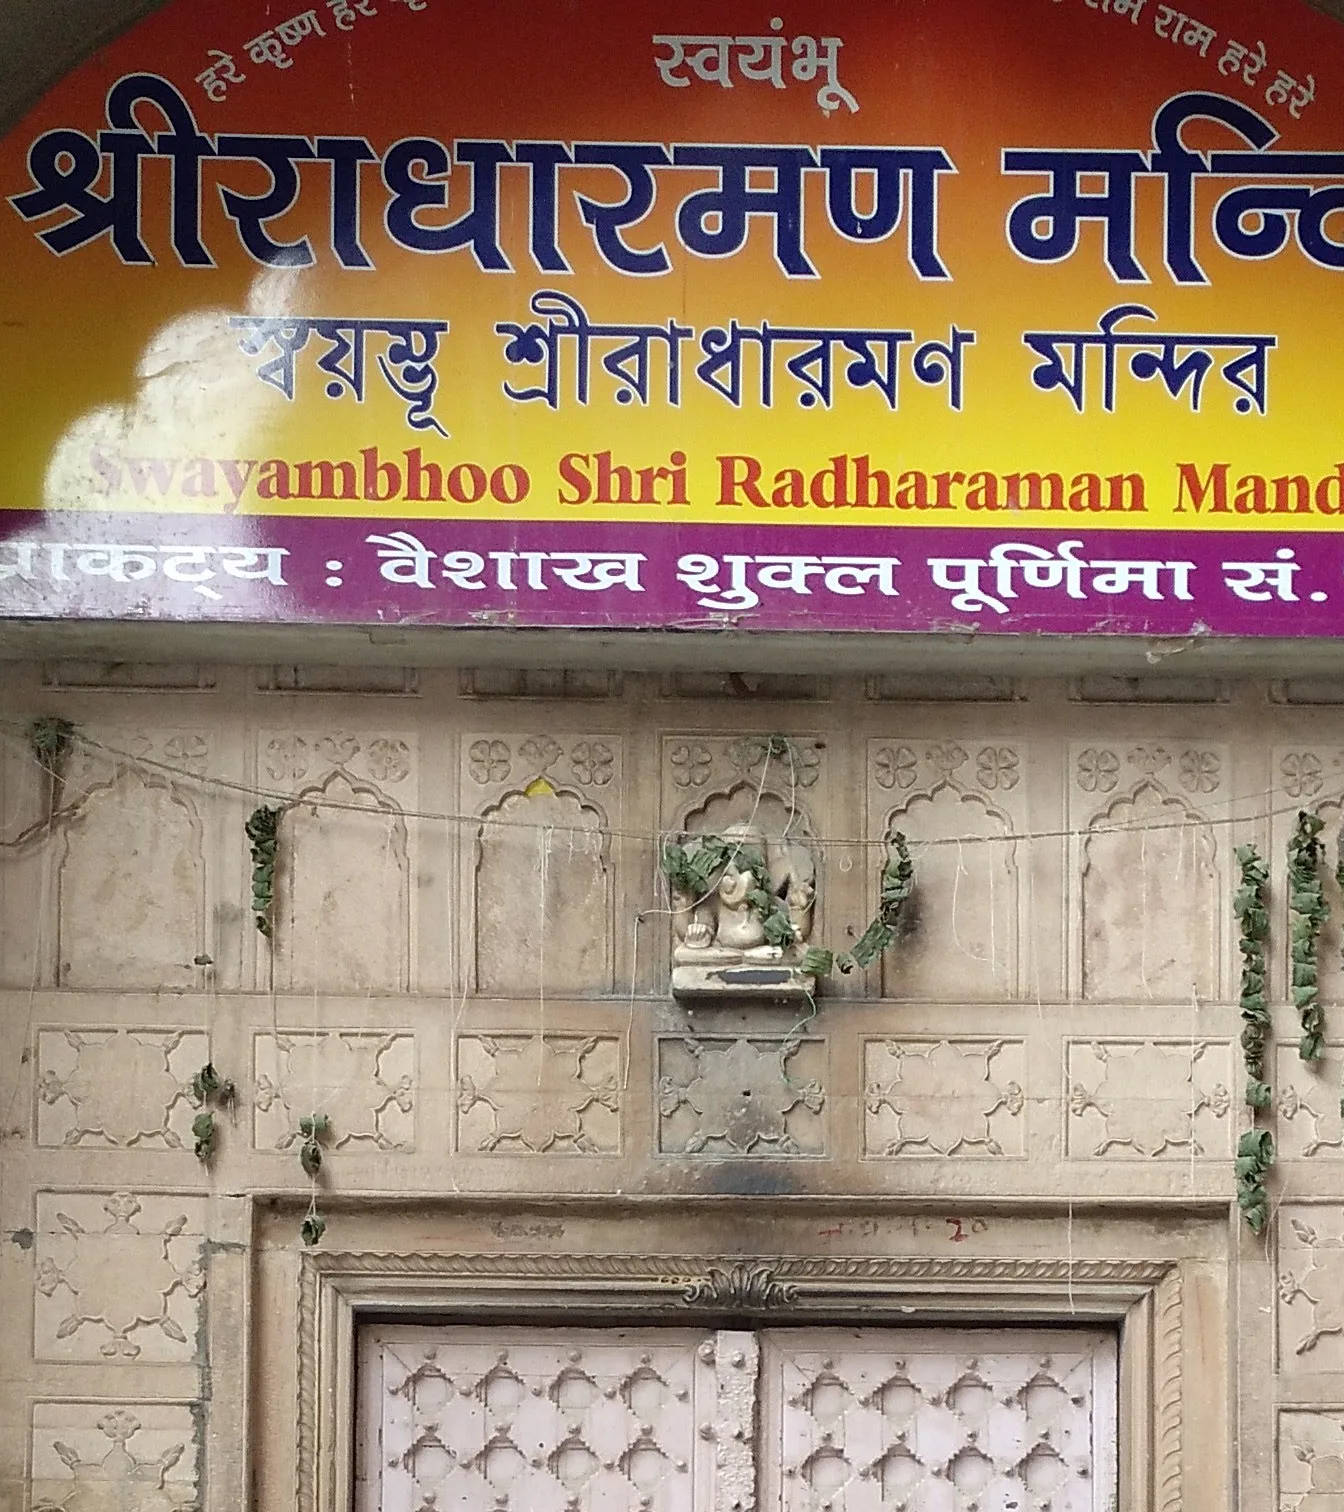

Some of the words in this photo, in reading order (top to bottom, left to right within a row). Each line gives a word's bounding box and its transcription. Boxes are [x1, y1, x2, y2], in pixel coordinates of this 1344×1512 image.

[195, 50, 246, 101] हरे
[243, 10, 326, 69] कृष्ण
[652, 16, 860, 114] स्वयंभू
[1155, 4, 1217, 57] राम
[1218, 40, 1267, 86] हरे
[1265, 70, 1315, 120] हरे
[6, 73, 957, 282] श्रीराधारमण
[495, 289, 976, 412] শ্রীরাধারমণ
[1021, 303, 1278, 416] মন্দির
[88, 446, 531, 514] Swayambhoo
[557, 449, 690, 506] Shri
[715, 454, 1148, 513] Radharaman
[365, 531, 647, 592] वैशाख
[676, 552, 902, 611] शुक्ल
[927, 541, 1197, 614] पूर्णिमा
[1222, 547, 1328, 602] सं.
